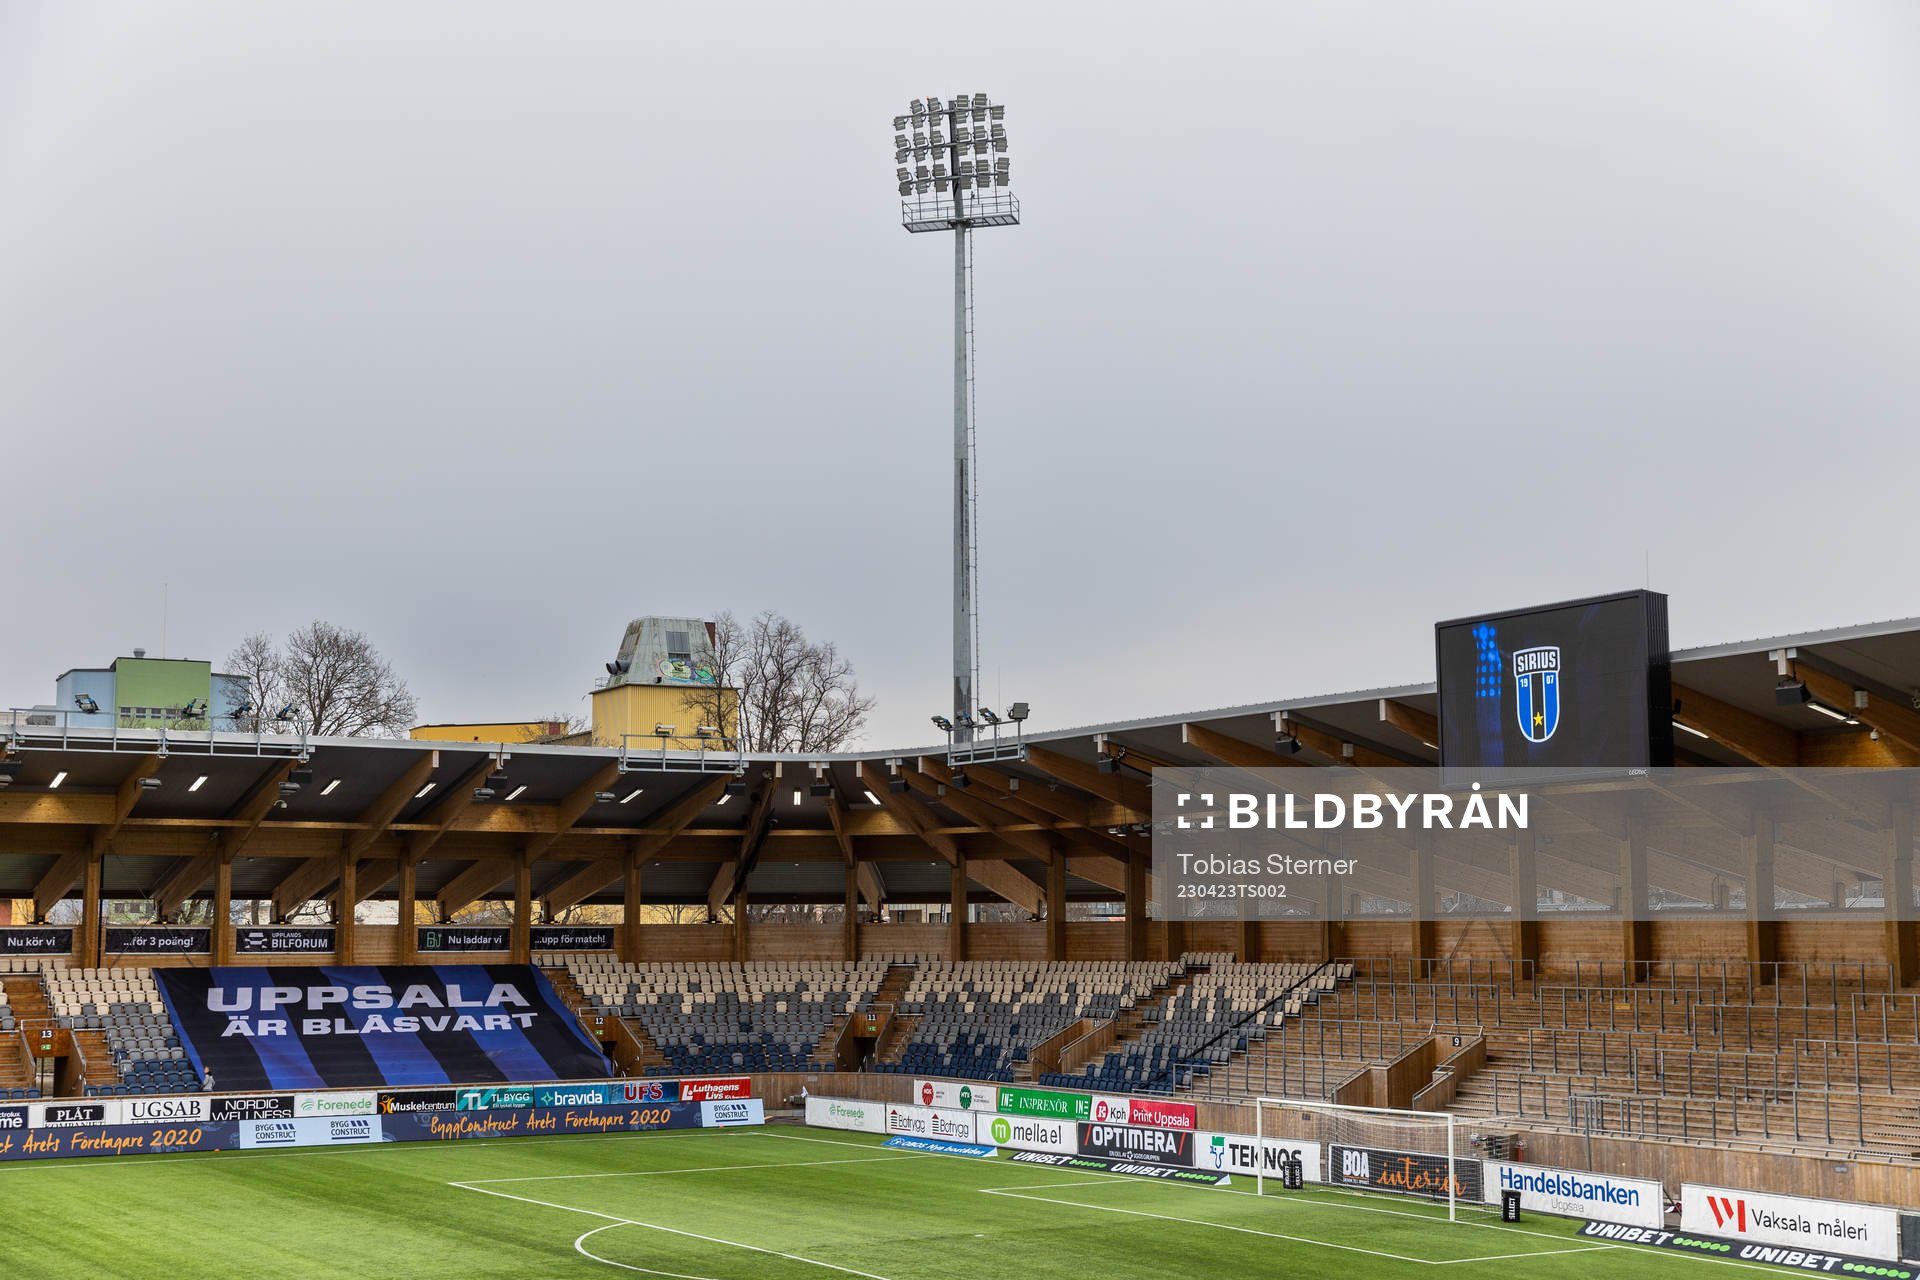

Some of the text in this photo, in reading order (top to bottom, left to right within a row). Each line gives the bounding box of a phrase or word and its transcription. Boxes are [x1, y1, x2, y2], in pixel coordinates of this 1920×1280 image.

[1517, 651, 1556, 672] SIRIUS
[8, 936, 56, 946] Nu kör vi
[149, 936, 156, 946] 3
[158, 936, 194, 948] poäng!
[271, 938, 328, 949] BILFORUM
[448, 935, 502, 944] Nu laddar vi
[560, 933, 574, 943] för
[576, 932, 606, 943] match!
[207, 984, 530, 1012] UPPSALA
[221, 1013, 538, 1037] ÄR BLÅSVART
[41, 1030, 52, 1039] 13
[1454, 1037, 1460, 1046] 9
[624, 1083, 663, 1101] UFS
[693, 1084, 740, 1092] Luthagens
[491, 1092, 530, 1102] TL BYGG
[554, 1090, 603, 1106] bravida
[705, 1091, 724, 1100] Livs
[132, 1101, 201, 1118] UGSAB
[225, 1098, 279, 1111] NORDIC
[317, 1098, 373, 1110] Forenede
[390, 1101, 455, 1111] Muskelcentrum
[714, 1104, 730, 1112] BYGG
[56, 1107, 93, 1120] PLÅT
[714, 1111, 749, 1119] CONSTRUCT
[1110, 1107, 1190, 1127] Kph Print Uppsala
[255, 1124, 275, 1132] BYGG
[330, 1120, 350, 1128] BYGG
[430, 1109, 671, 1139] ByggConstruct Årets Företagare 2020
[898, 1114, 926, 1134] Botrygg
[940, 1119, 969, 1139] Botrygg
[255, 1131, 296, 1140] CONSTRUCT
[330, 1128, 370, 1136] CONSTRUCT
[23, 1130, 60, 1154] Årets
[71, 1130, 143, 1155] Företagare
[150, 1128, 202, 1147] 2020
[1092, 1126, 1177, 1153] OPTIMERA
[1013, 1151, 1073, 1165] UNIBET
[1343, 1150, 1369, 1178] BOA
[1110, 1163, 1178, 1178] UNIBET
[1500, 1166, 1639, 1207] Handelsbanken
[1751, 1208, 1868, 1241] Vaksala måleri
[1585, 1222, 1674, 1245] UNIBET
[1740, 1245, 1842, 1271] UNIBET
